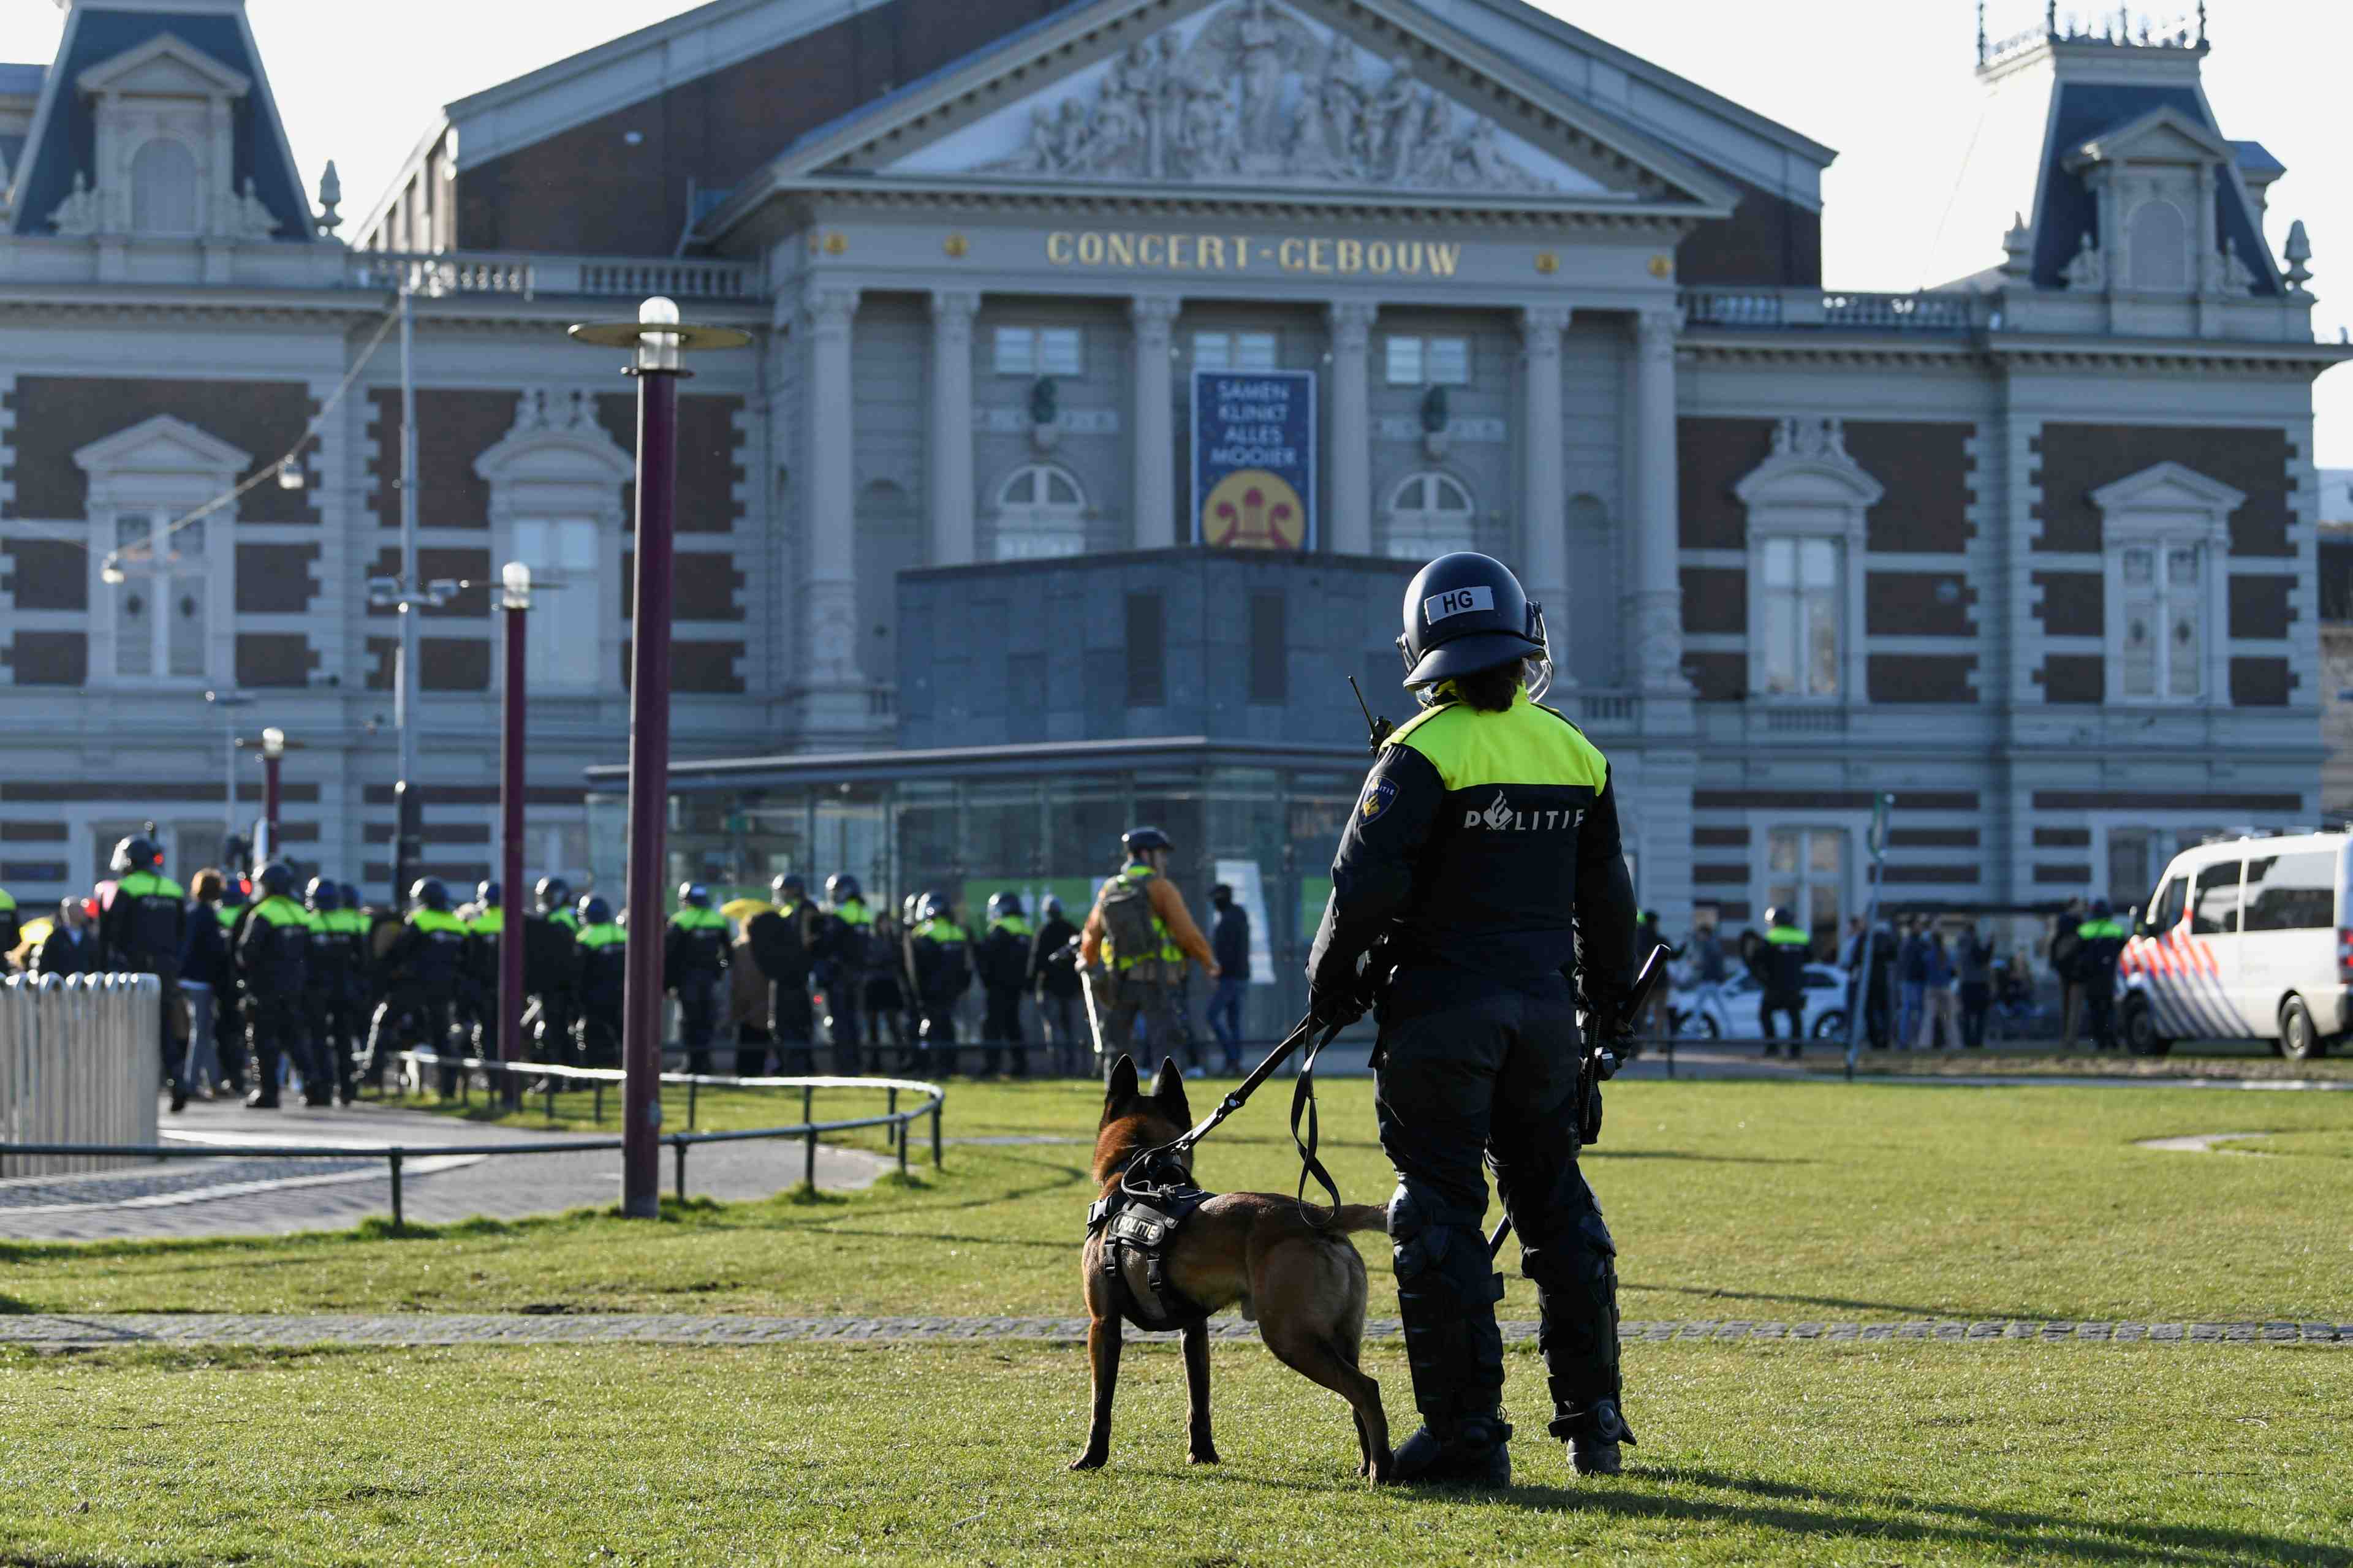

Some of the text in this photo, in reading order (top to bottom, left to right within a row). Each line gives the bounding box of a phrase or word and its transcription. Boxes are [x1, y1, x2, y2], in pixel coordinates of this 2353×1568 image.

[1045, 232, 1461, 276] CONCERT-GEBOUW
[1217, 381, 1290, 399] SAMEN
[1224, 425, 1283, 444] ALLES
[1443, 591, 1474, 613] HG
[1118, 1216, 1158, 1239] POLITIE
